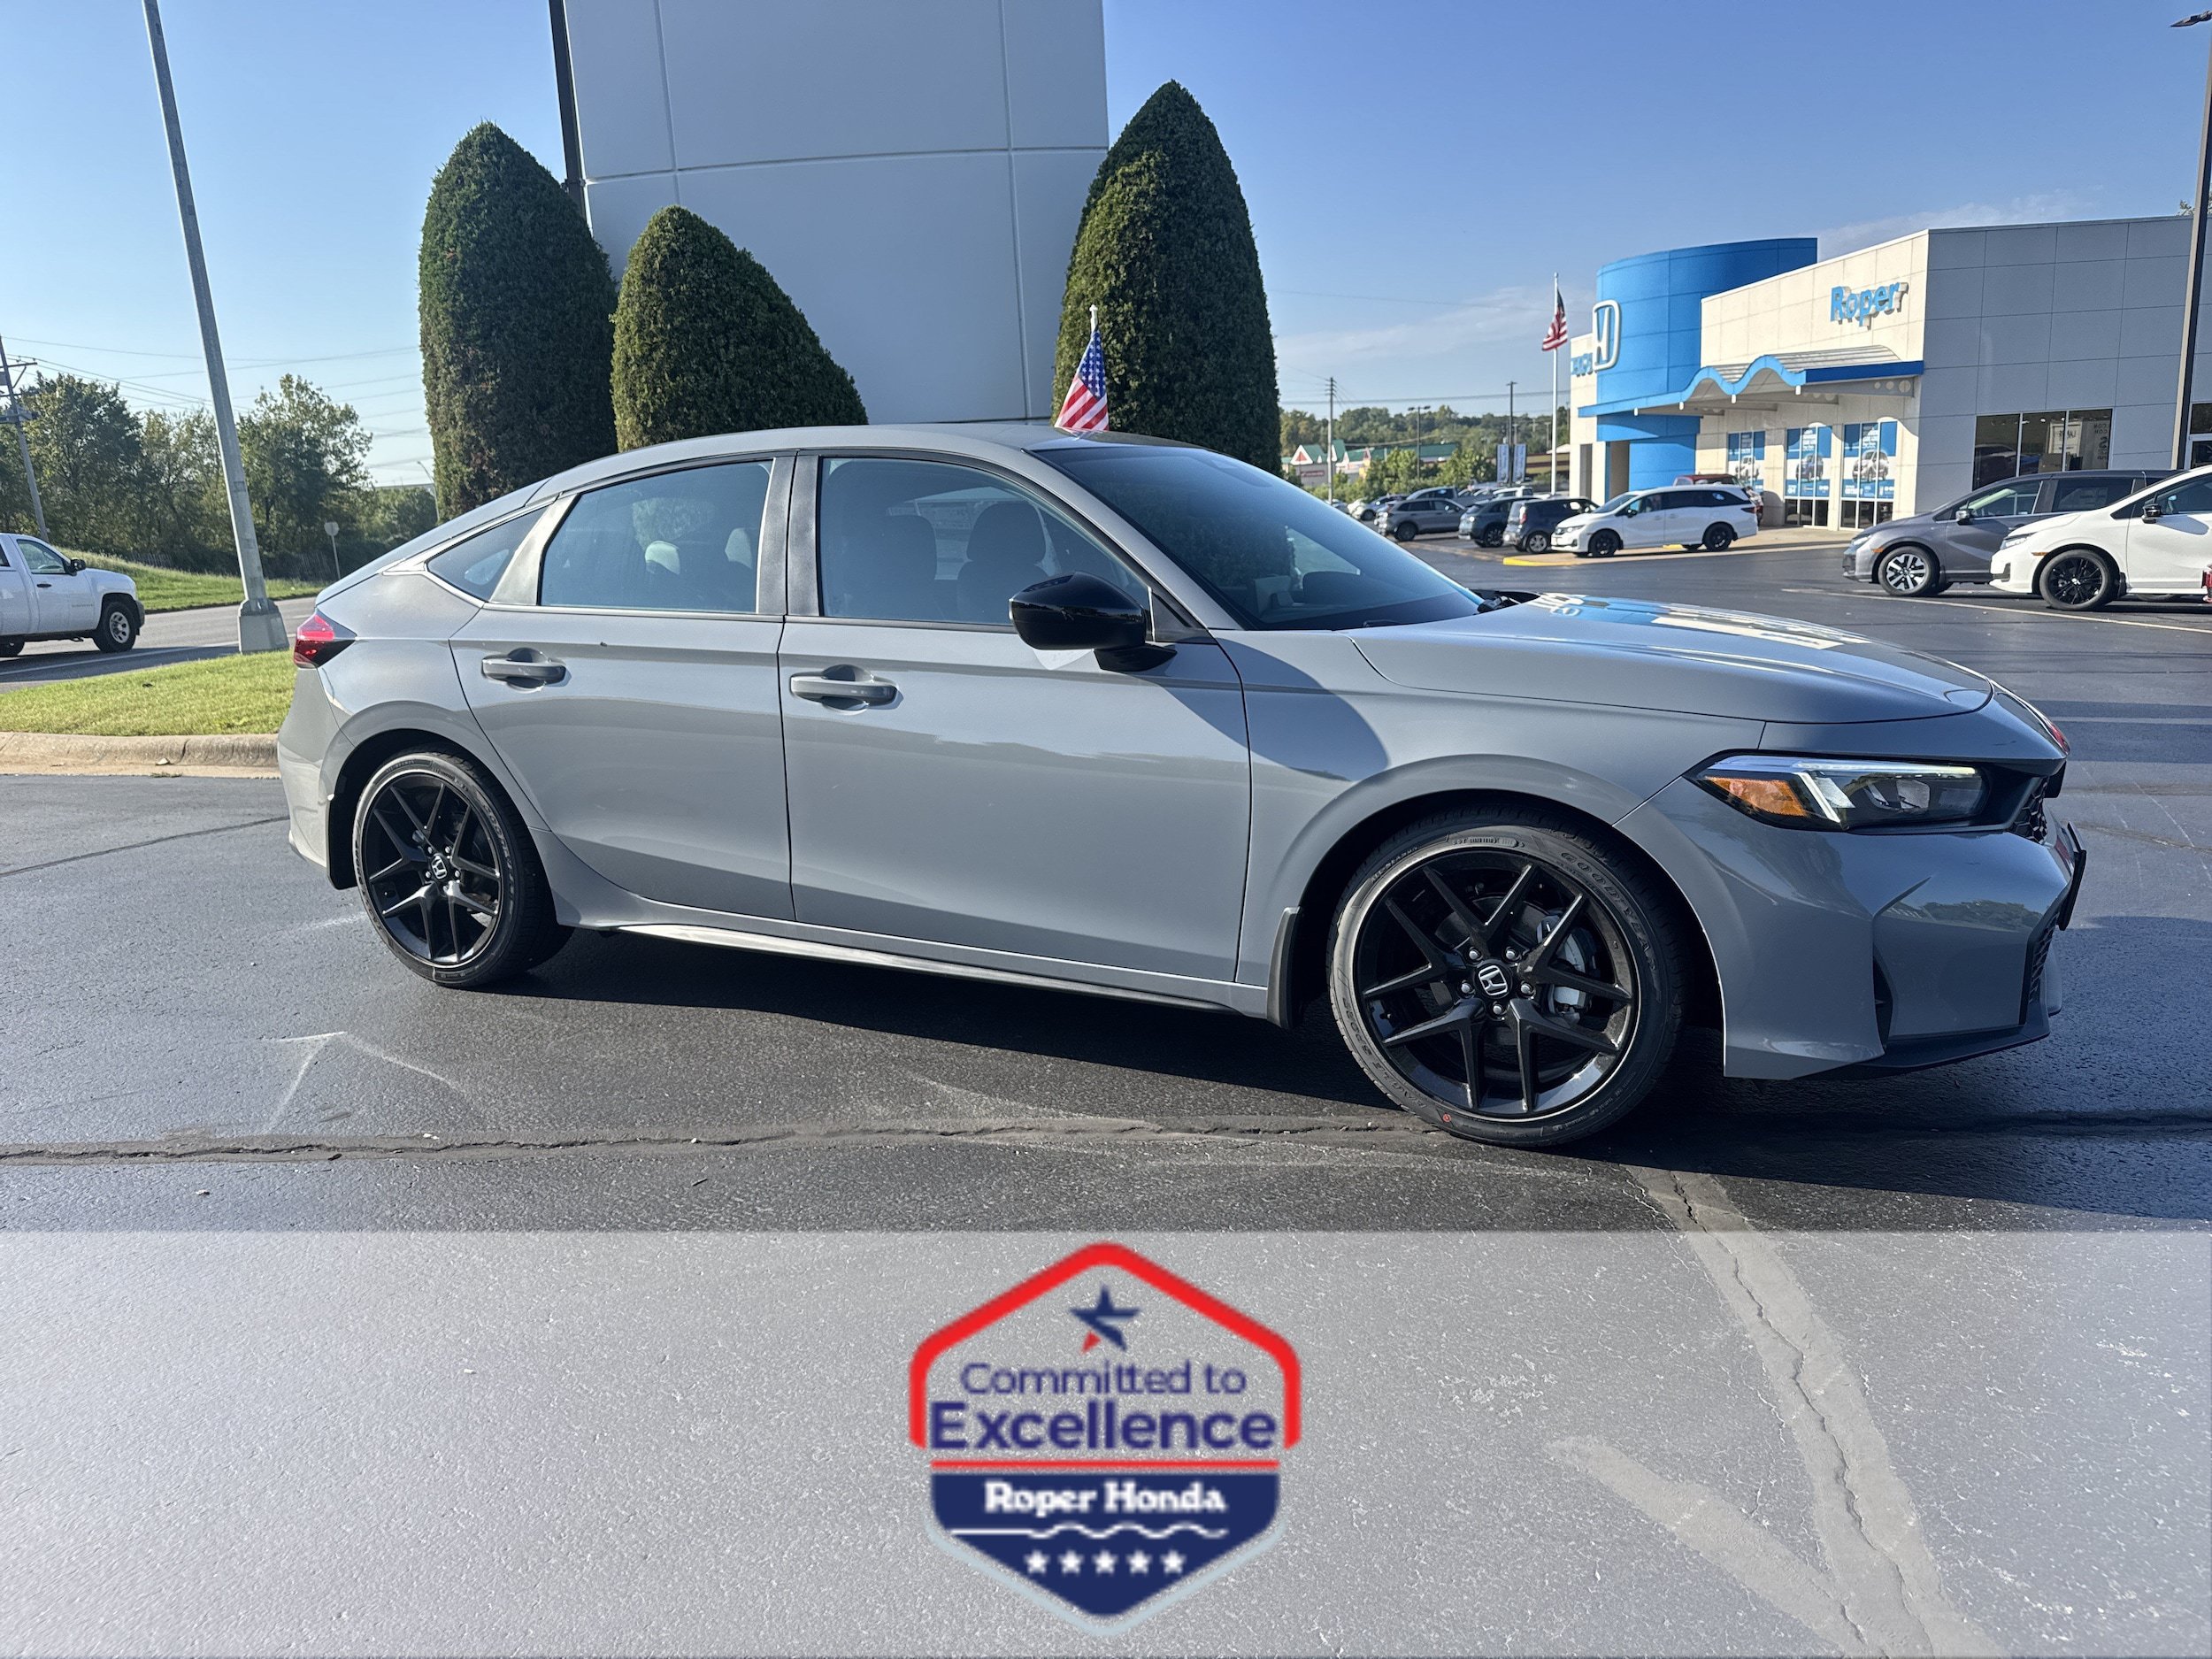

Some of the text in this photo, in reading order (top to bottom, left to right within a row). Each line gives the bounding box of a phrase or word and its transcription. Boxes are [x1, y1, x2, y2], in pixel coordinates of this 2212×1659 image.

[1831, 281, 1908, 329] Roper
[1561, 851, 1657, 971] GOODYEAR
[1342, 996, 1373, 1057] SPORT
